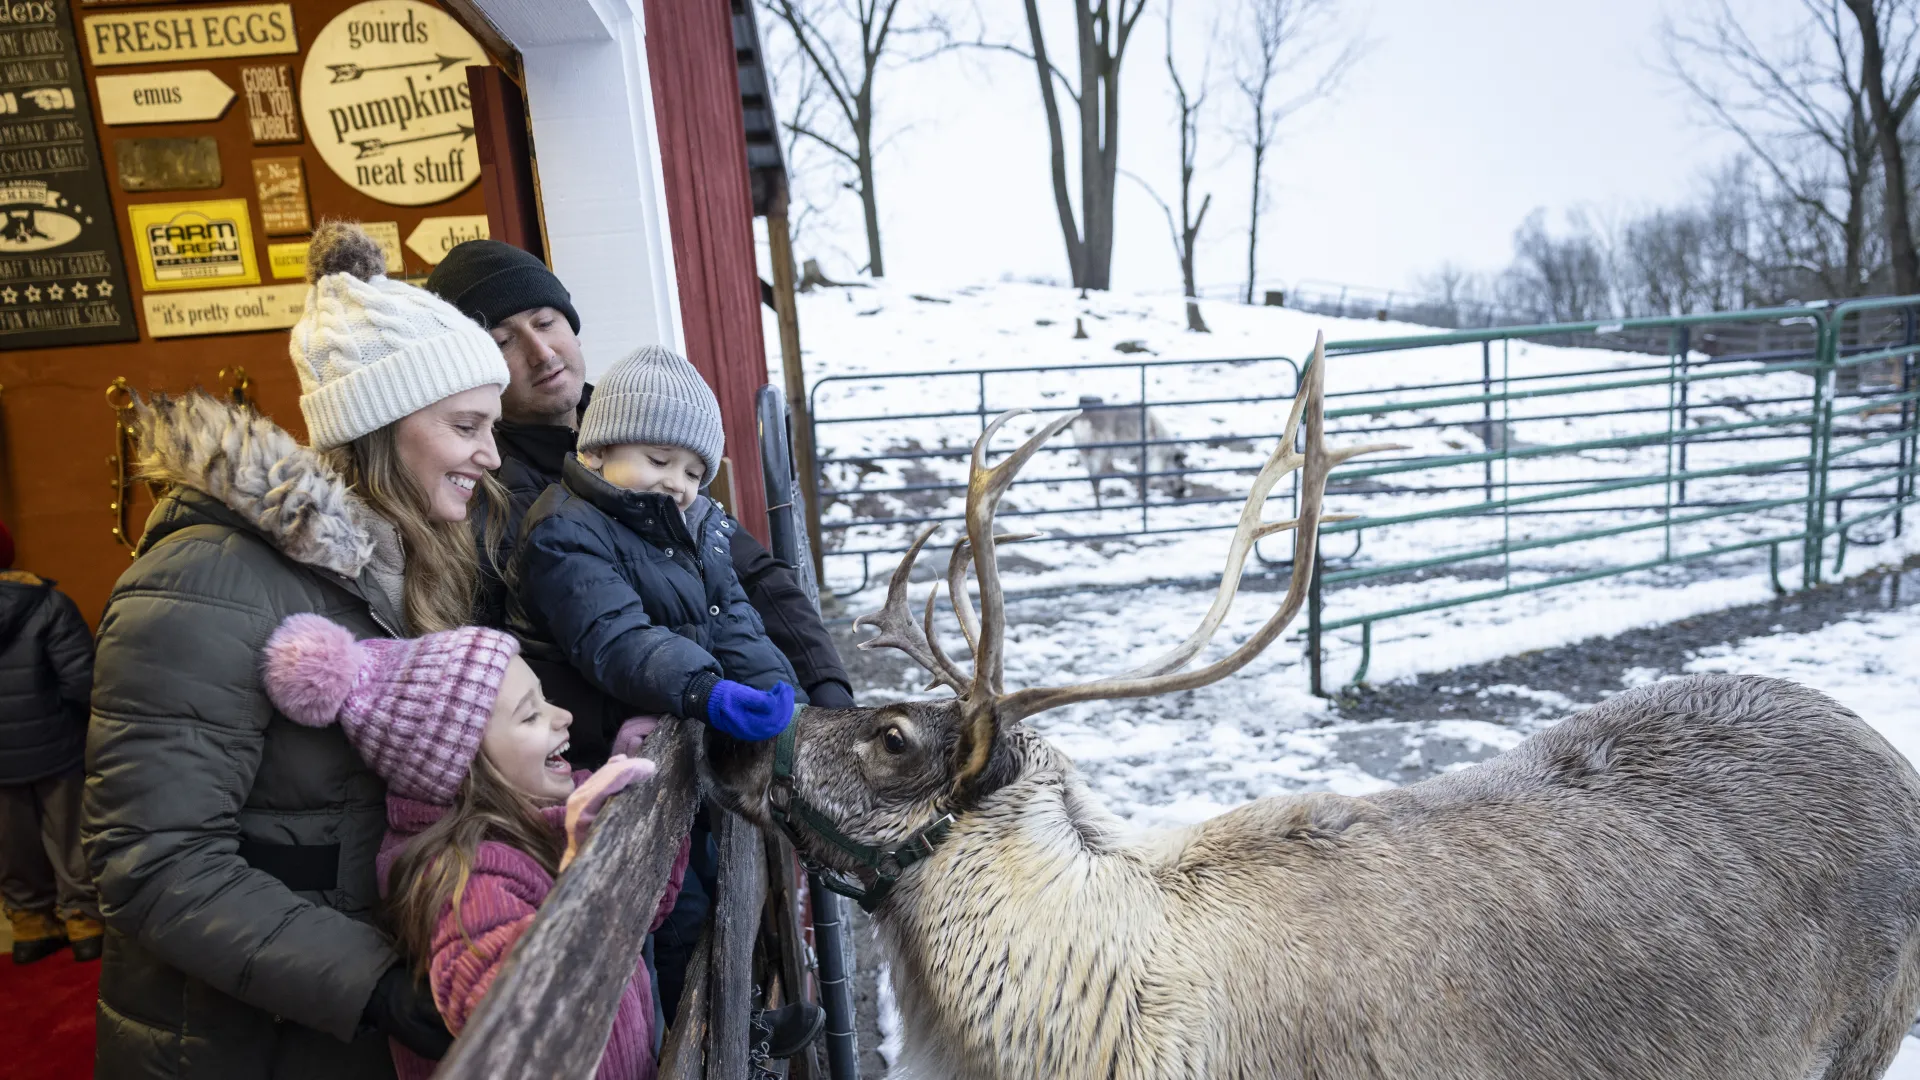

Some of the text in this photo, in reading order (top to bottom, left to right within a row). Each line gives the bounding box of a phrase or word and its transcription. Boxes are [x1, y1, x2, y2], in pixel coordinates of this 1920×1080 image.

[93, 12, 286, 54] FRESH EGGS
[347, 9, 428, 49] gourds
[242, 66, 289, 93] GOBBLE
[133, 87, 182, 106] emus
[267, 90, 293, 117] YOU
[329, 75, 474, 144] pumpkins
[250, 115, 298, 140] WOBBLE
[355, 148, 465, 186] neat stuff
[150, 222, 236, 243] FARM
[153, 240, 238, 256] BUREAU
[188, 301, 229, 327] pretty
[235, 295, 275, 320] cool."
